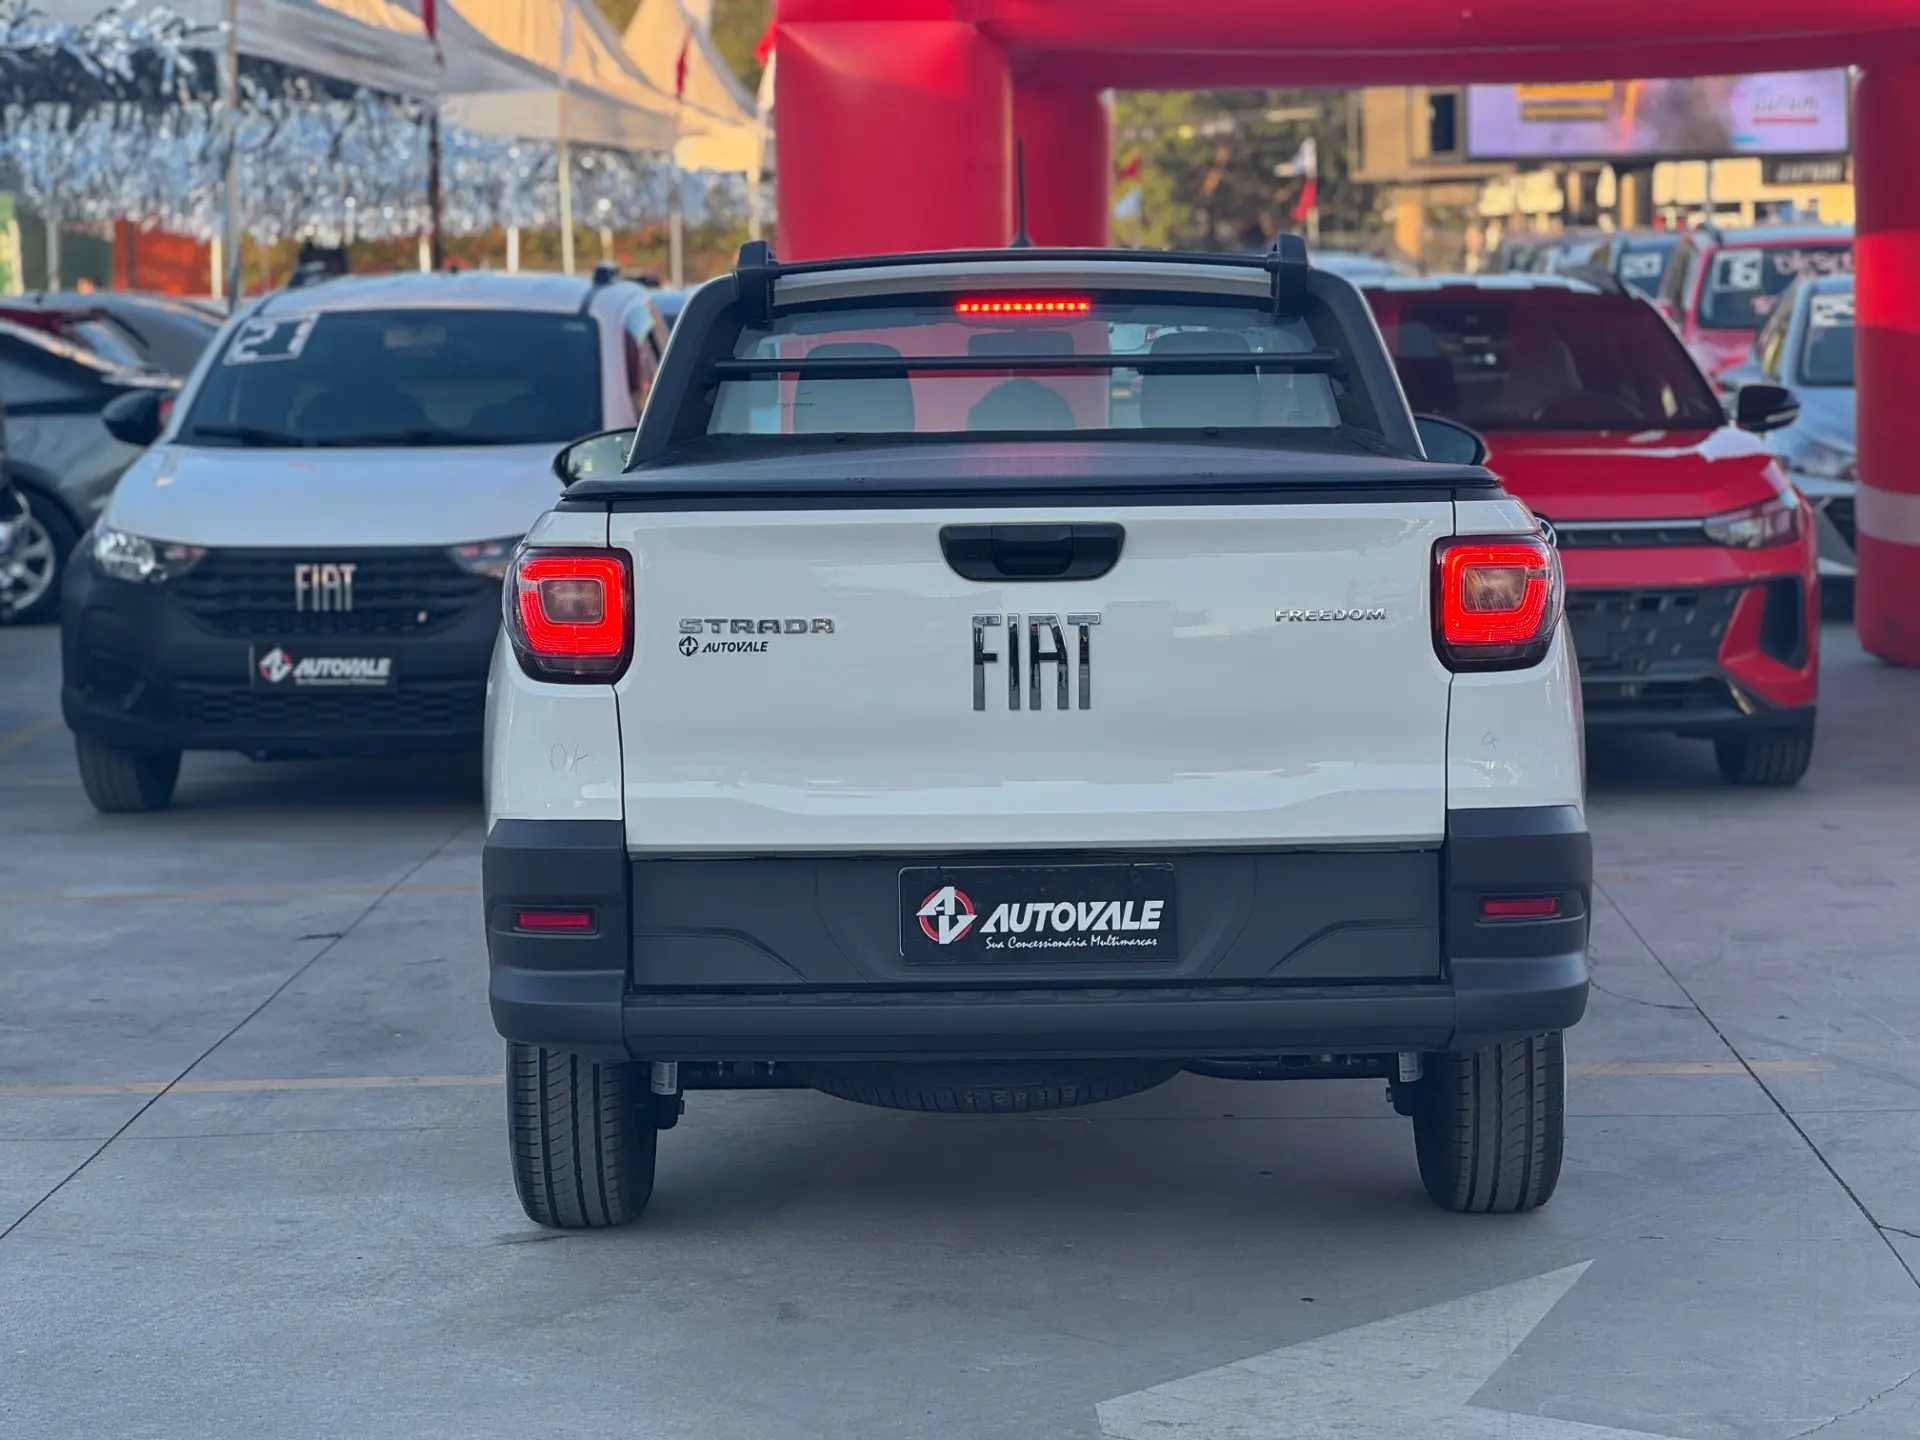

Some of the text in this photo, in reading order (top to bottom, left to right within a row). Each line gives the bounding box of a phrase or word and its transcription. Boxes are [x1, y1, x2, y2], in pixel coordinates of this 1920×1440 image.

[295, 563, 357, 612] FIAT
[1275, 607, 1387, 622] FREEDOM
[678, 618, 835, 634] STRADA
[702, 641, 769, 653] AUTOVALE
[293, 657, 392, 677] AUTOVALE
[972, 612, 1101, 711] FIAT
[979, 900, 1165, 933] AUTOVALE
[985, 934, 1158, 949] Sua Concessionária Multimarcas
